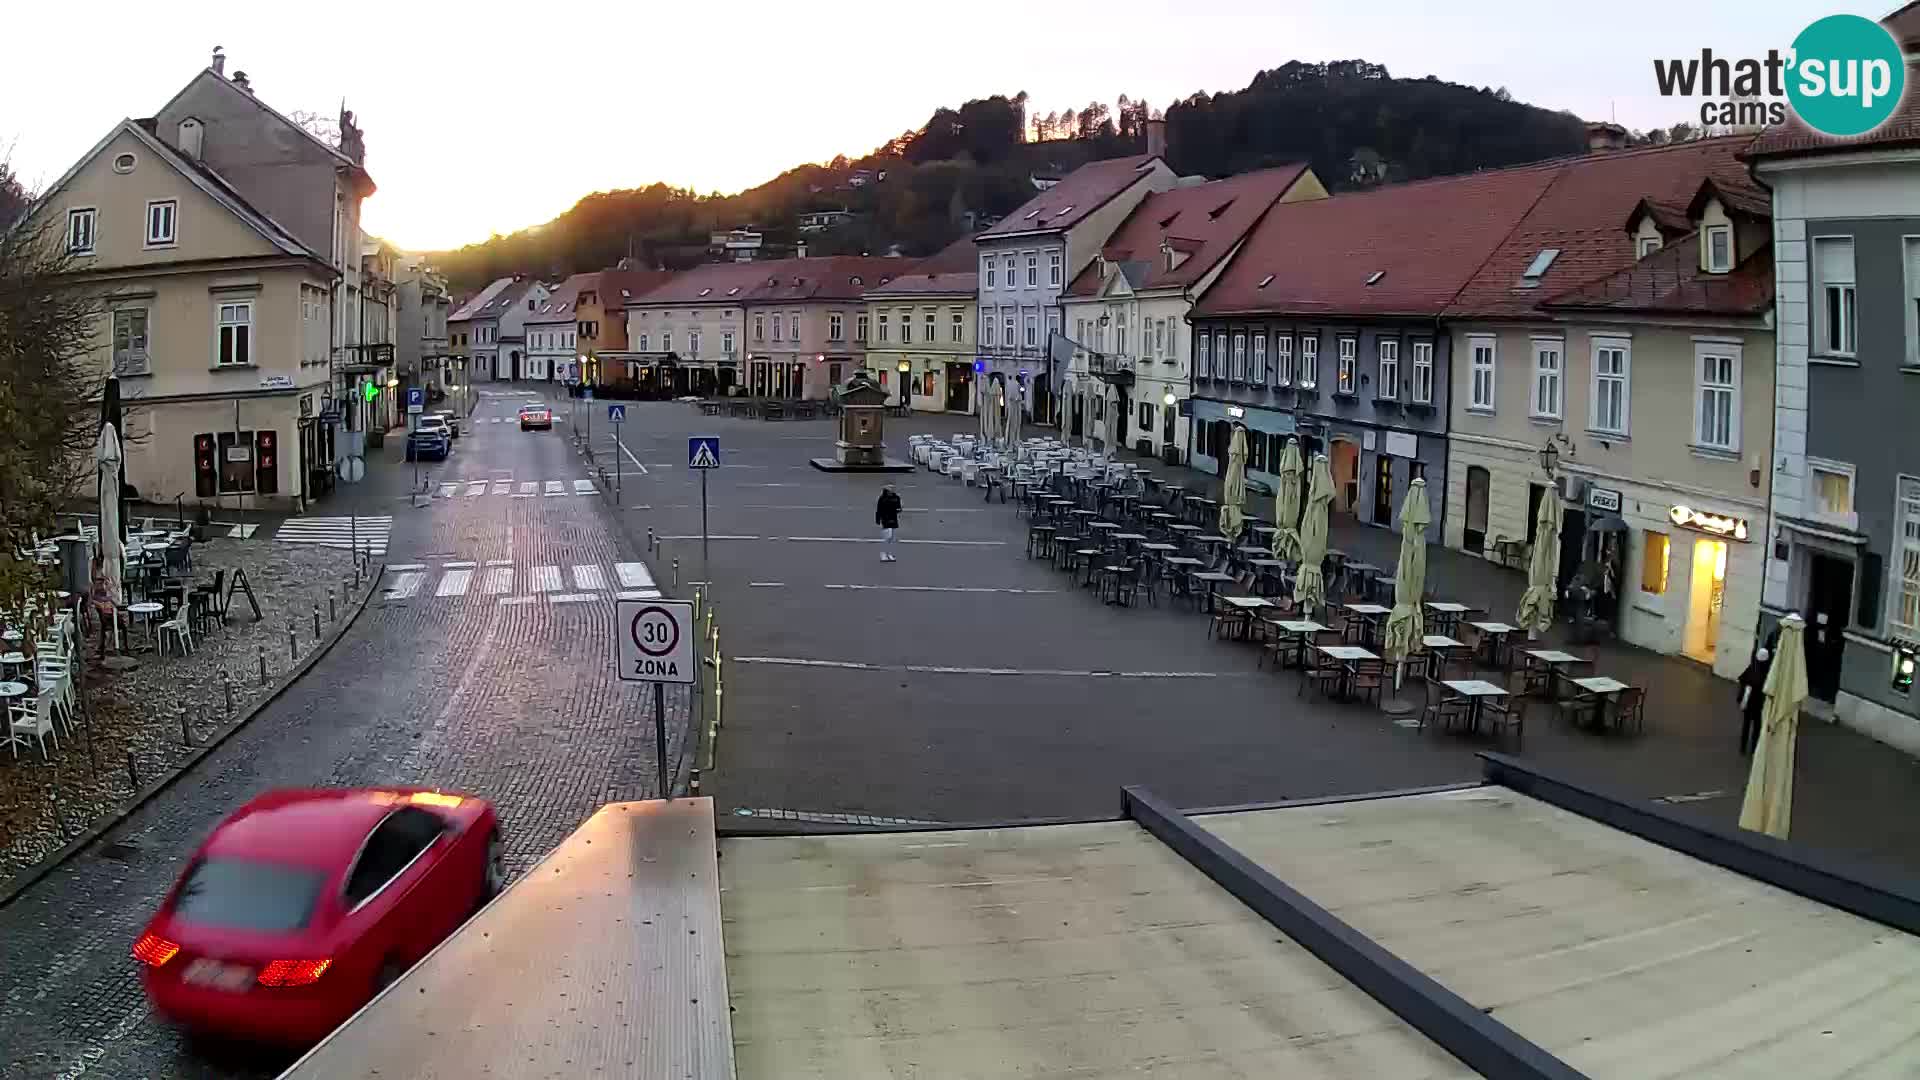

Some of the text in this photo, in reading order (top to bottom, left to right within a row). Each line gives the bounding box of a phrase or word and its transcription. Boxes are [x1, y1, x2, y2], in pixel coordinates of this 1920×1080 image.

[411, 391, 420, 402] P
[644, 622, 668, 643] 30
[634, 659, 679, 677] ZONA
